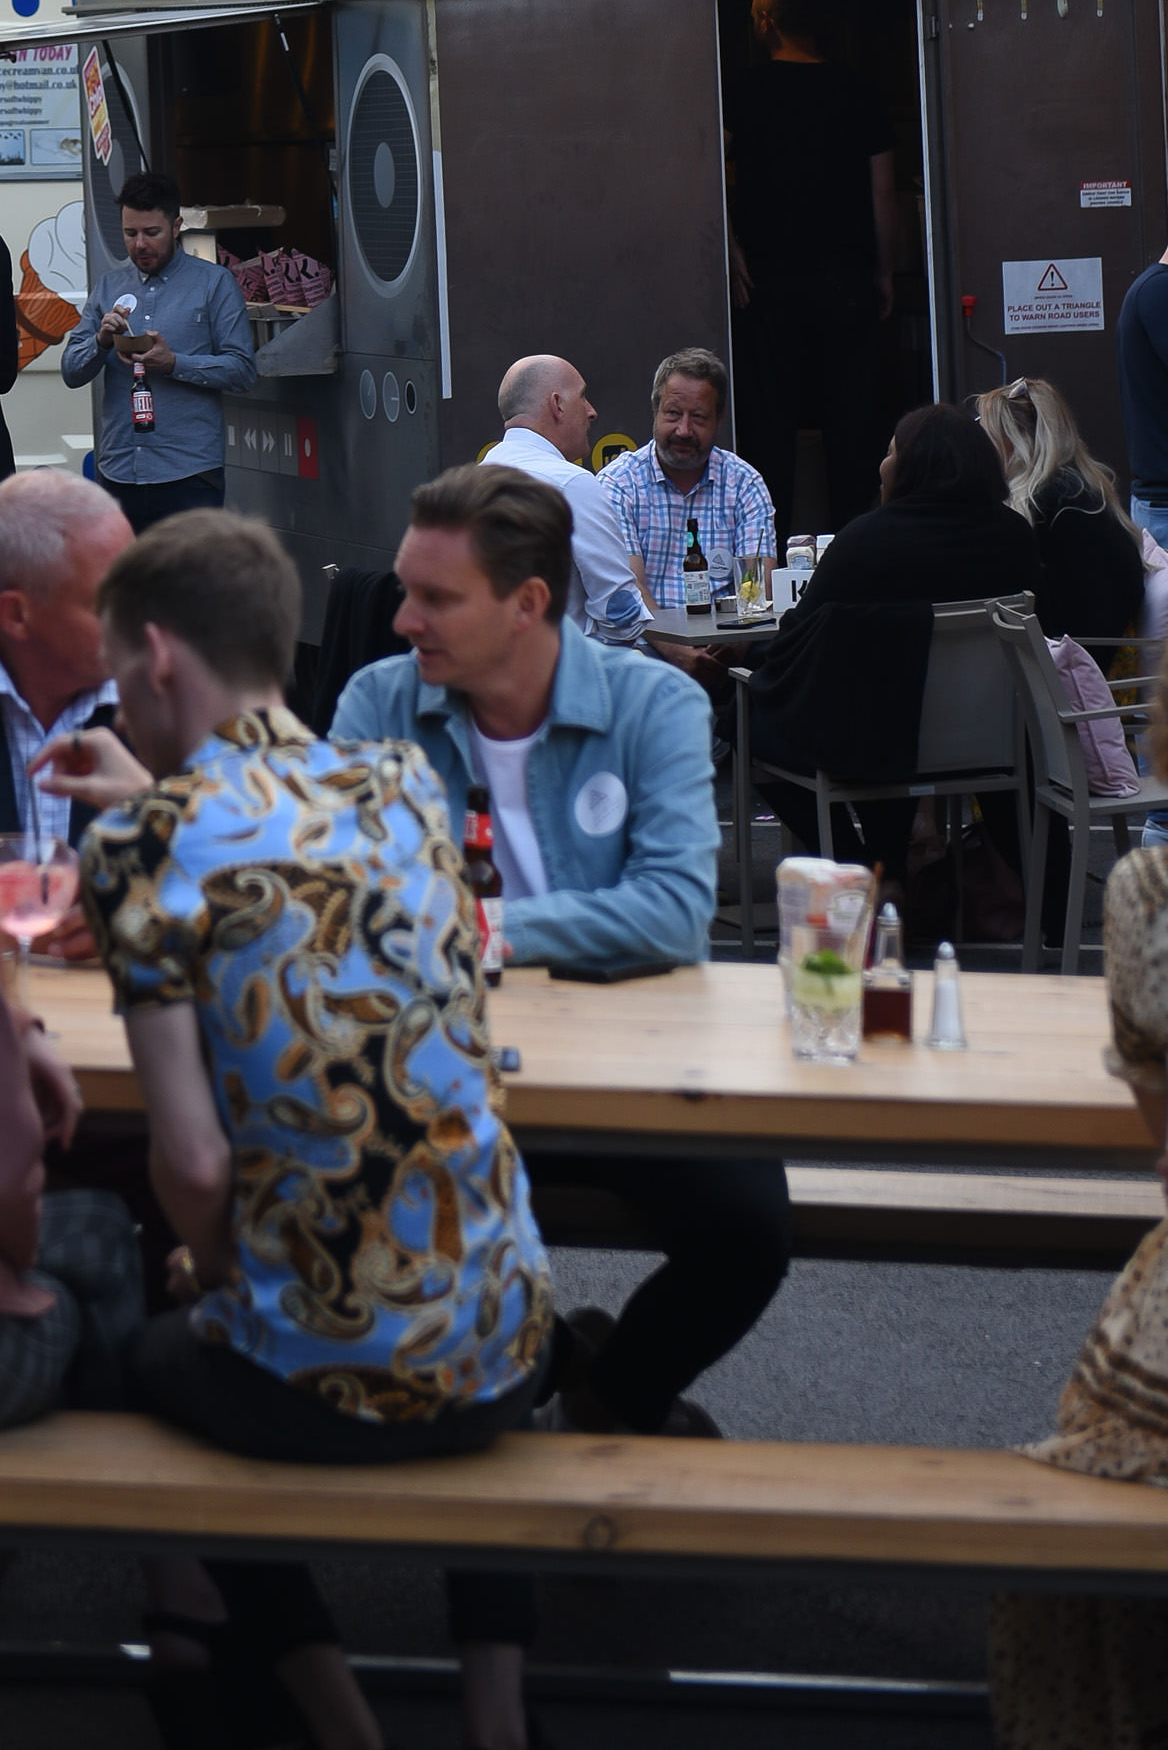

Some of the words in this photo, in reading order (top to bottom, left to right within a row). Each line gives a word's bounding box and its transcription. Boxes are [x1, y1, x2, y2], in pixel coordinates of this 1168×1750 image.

[1083, 181, 1128, 189] IMPORTANT
[1007, 304, 1033, 312] PLACE
[1035, 303, 1052, 311] OUT
[1062, 301, 1101, 310] TRIANGLE
[1009, 314, 1020, 322] TO
[1022, 312, 1046, 321] WARN
[1048, 311, 1071, 320] ROAD
[1073, 310, 1100, 319] USERS
